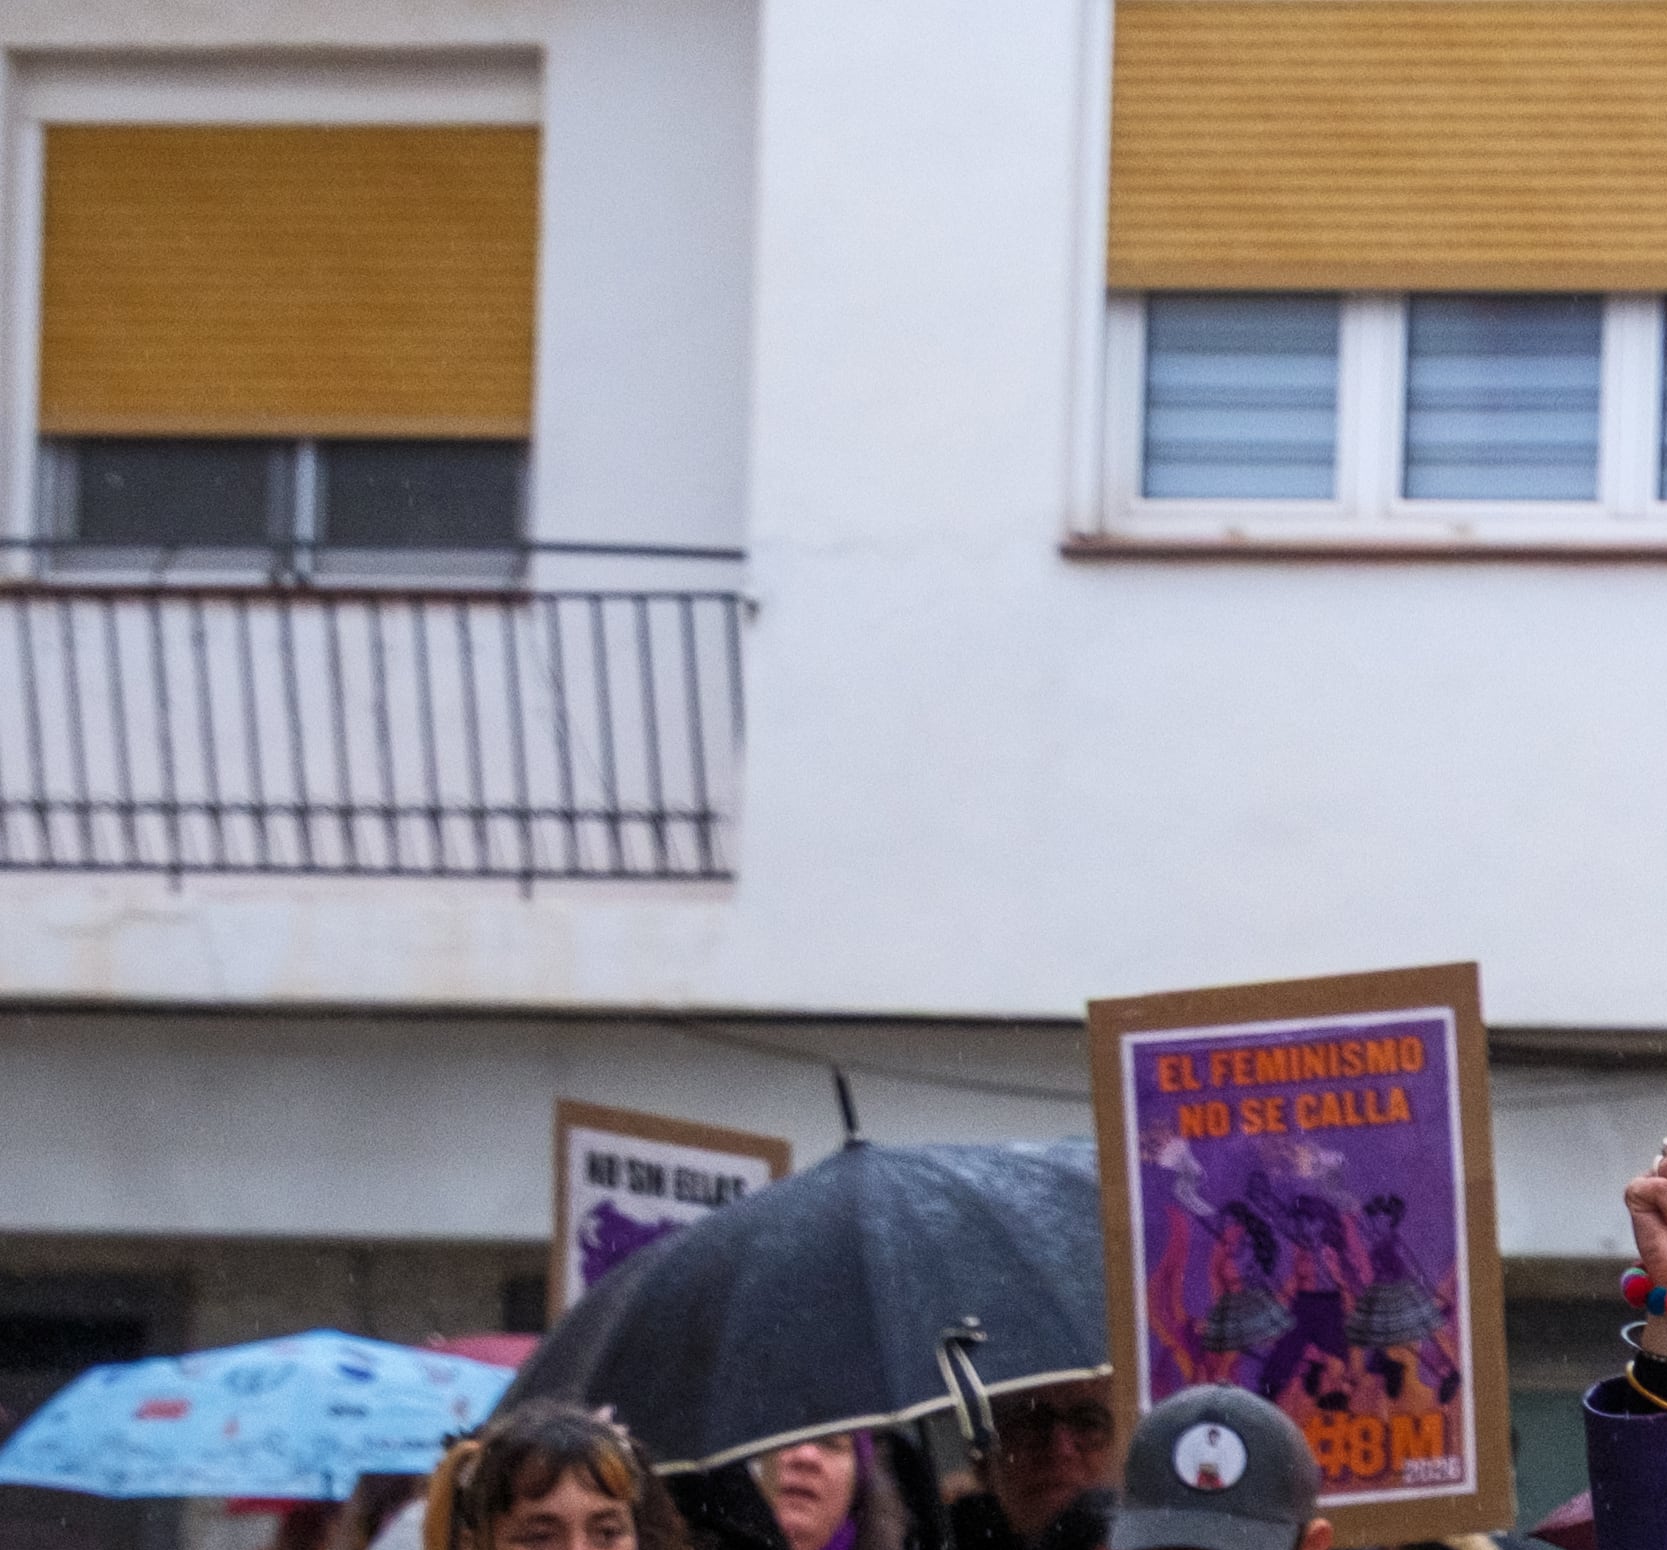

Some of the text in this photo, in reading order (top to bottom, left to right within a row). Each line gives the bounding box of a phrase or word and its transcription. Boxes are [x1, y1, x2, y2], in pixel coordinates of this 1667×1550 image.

[1157, 1035, 1425, 1093] EL FEMINISMO
[1178, 1086, 1412, 1139] NO SE CALLA
